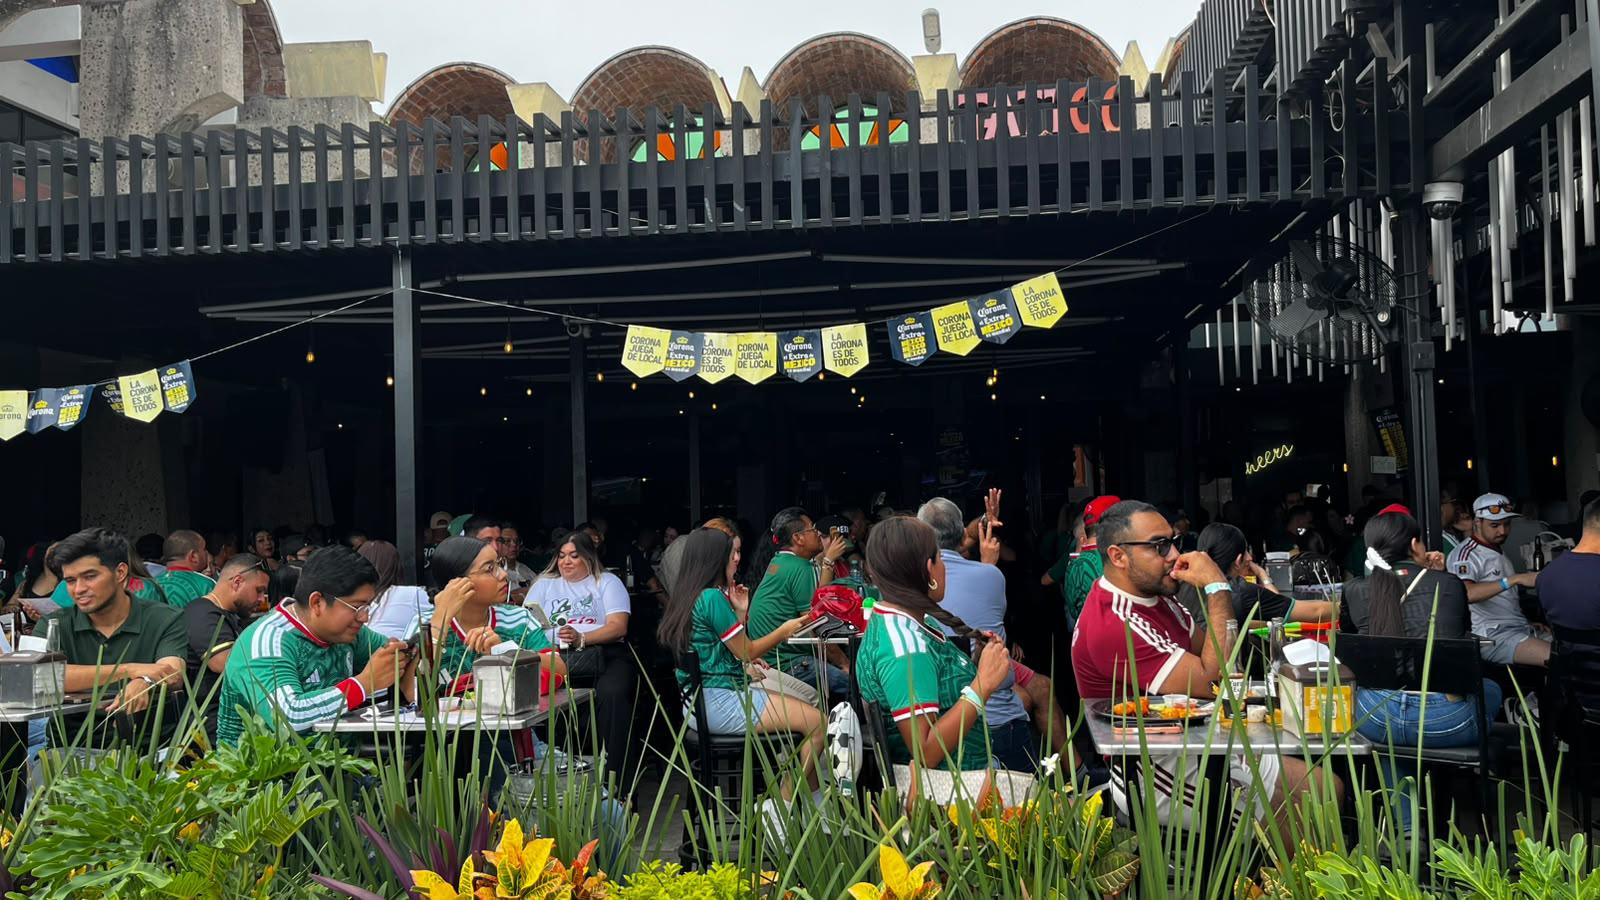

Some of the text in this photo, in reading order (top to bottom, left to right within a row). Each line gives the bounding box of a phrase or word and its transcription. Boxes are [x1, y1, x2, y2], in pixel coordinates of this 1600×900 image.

[1022, 286, 1035, 296] LA
[1024, 288, 1058, 305] CORONA
[977, 303, 1008, 318] Corona
[1028, 298, 1052, 313] ES DE
[1031, 306, 1058, 321] TODOS
[938, 311, 971, 327] CORONA
[983, 314, 1005, 325] Extra
[897, 322, 924, 333] Corona
[941, 321, 968, 335] JUEGA
[831, 332, 843, 341] LA
[901, 332, 922, 340] Extra
[941, 328, 977, 344] DE LOCA
[630, 336, 662, 347] CORONA
[703, 339, 714, 347] LA
[831, 340, 864, 350] CORONA
[629, 344, 655, 353] JUEGA
[701, 347, 733, 357] CORONA
[737, 343, 769, 352] CORONA
[784, 342, 814, 353] Corona
[627, 352, 663, 364] DE LOCAL
[670, 352, 689, 360] Extra
[738, 351, 764, 360] JUEGA
[788, 352, 809, 360] Extra
[832, 348, 855, 359] ES DE
[702, 356, 723, 365] ES DE
[737, 360, 774, 369] DE LOCAL
[833, 357, 860, 367] TODOS
[701, 364, 726, 373] TODOS
[160, 371, 184, 384] Corona
[130, 380, 141, 389] LA
[130, 383, 158, 397] CORONA
[61, 393, 84, 402] Corona
[132, 396, 143, 405] ES
[142, 393, 153, 403] DE
[134, 401, 158, 413] TODOS
